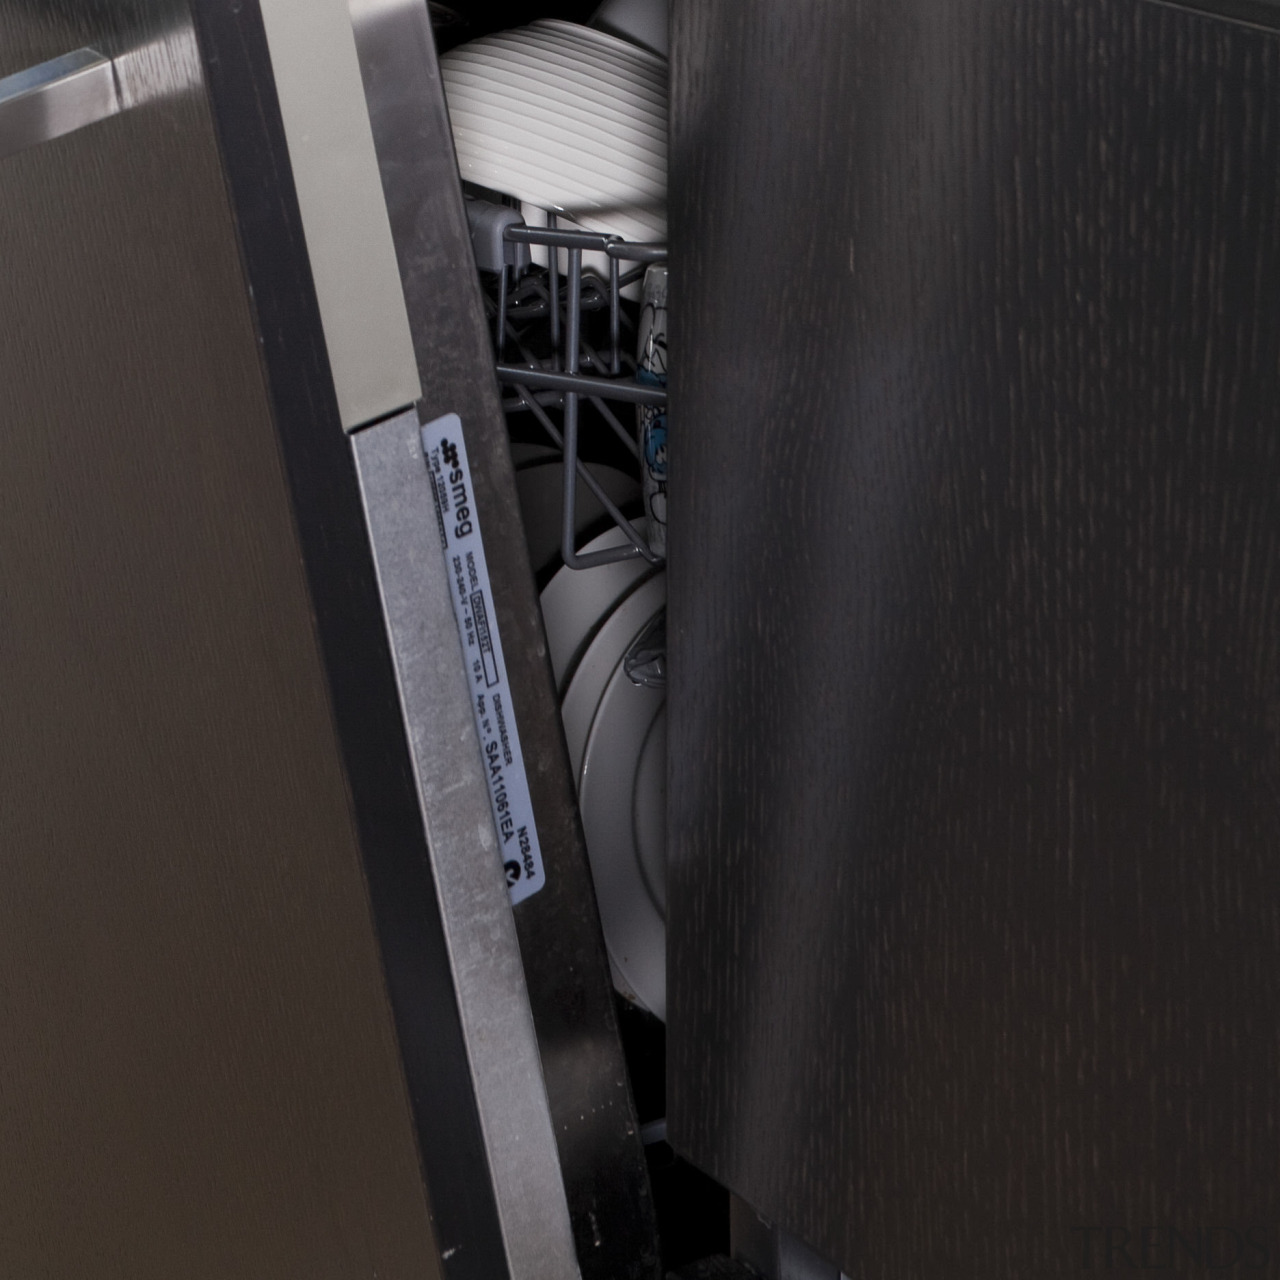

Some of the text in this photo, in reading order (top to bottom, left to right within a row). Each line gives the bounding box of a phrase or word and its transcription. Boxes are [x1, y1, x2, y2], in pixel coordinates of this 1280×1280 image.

[430, 446, 441, 474] Type
[448, 468, 474, 539] smeg
[465, 550, 479, 592] MODEL
[493, 692, 513, 767] DISHWASHER
[466, 630, 476, 647] Hz
[475, 674, 483, 684] A
[485, 740, 515, 845] SAA11061EA
[517, 825, 536, 880] N28484
